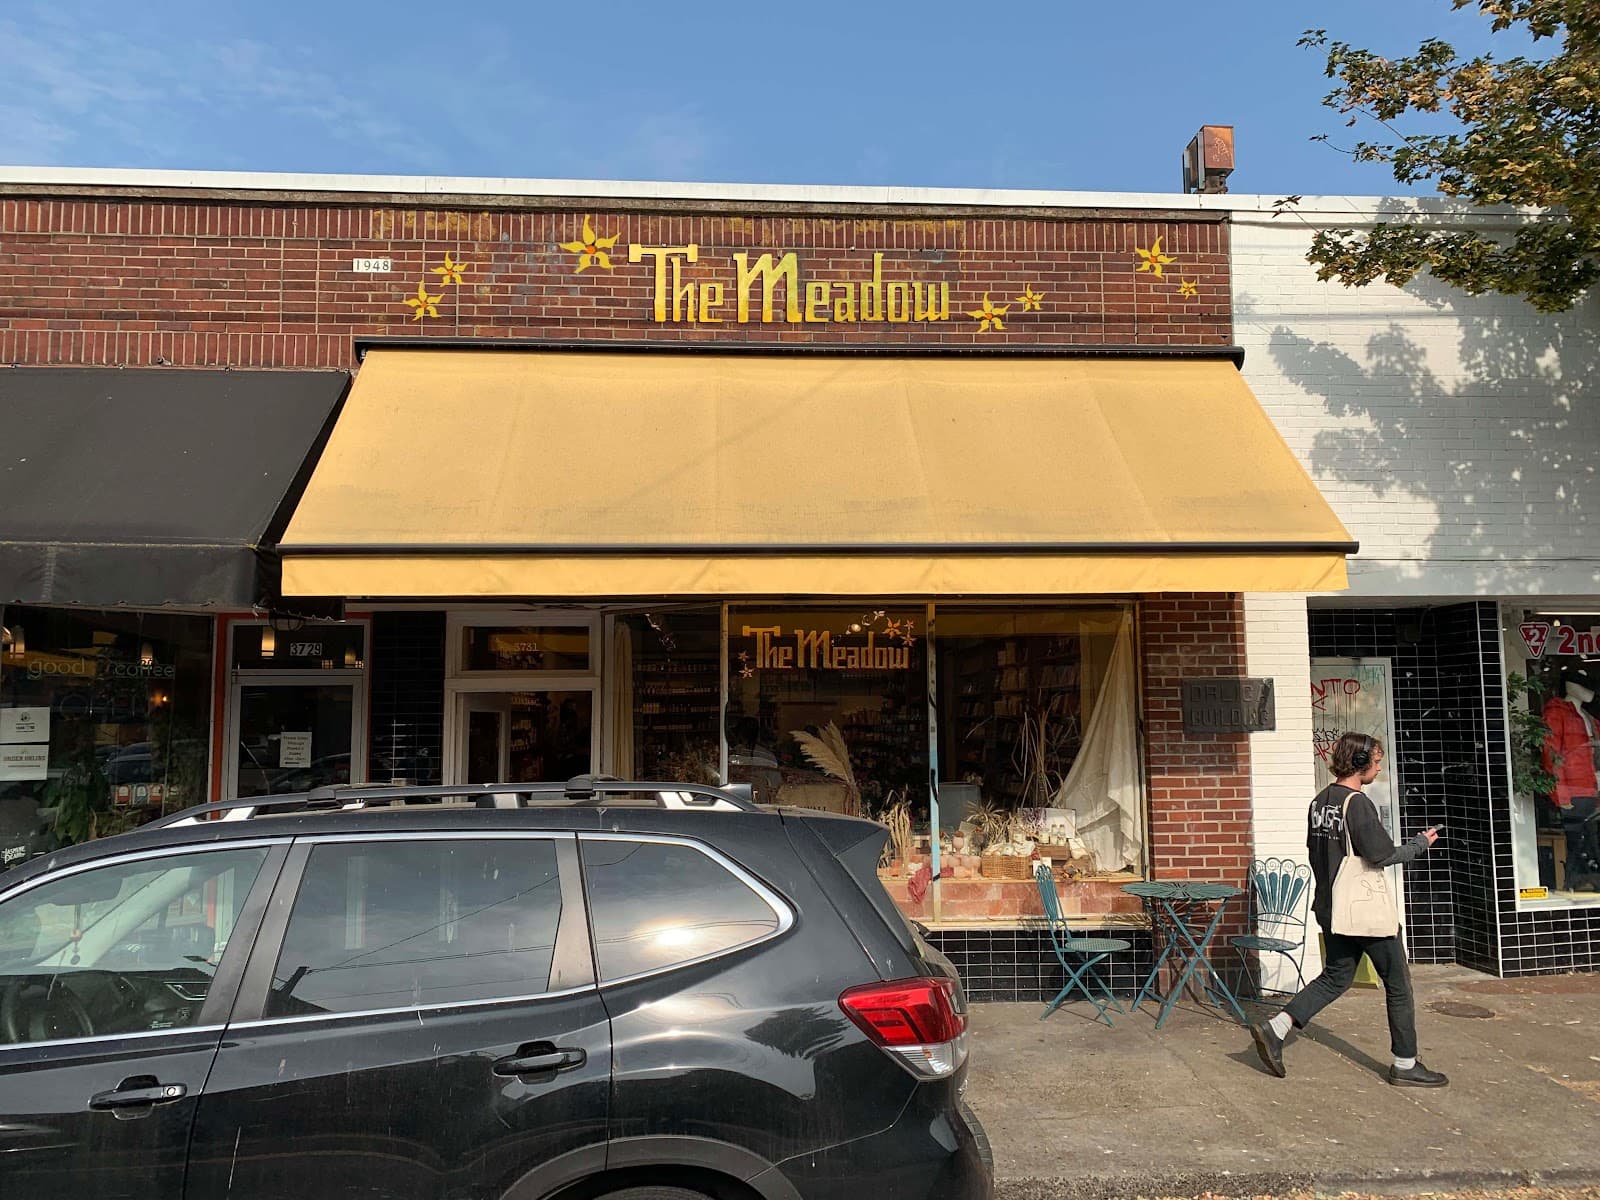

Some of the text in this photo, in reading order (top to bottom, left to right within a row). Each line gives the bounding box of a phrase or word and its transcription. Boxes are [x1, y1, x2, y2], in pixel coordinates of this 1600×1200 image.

[356, 259, 389, 271] 1948
[629, 244, 949, 323] The Meadow
[290, 643, 322, 656] 3729
[742, 626, 909, 669] The Meadow
[1558, 625, 1600, 654] 2n
[28, 657, 174, 679] good coffee
[1190, 707, 1269, 727] BUILDING
